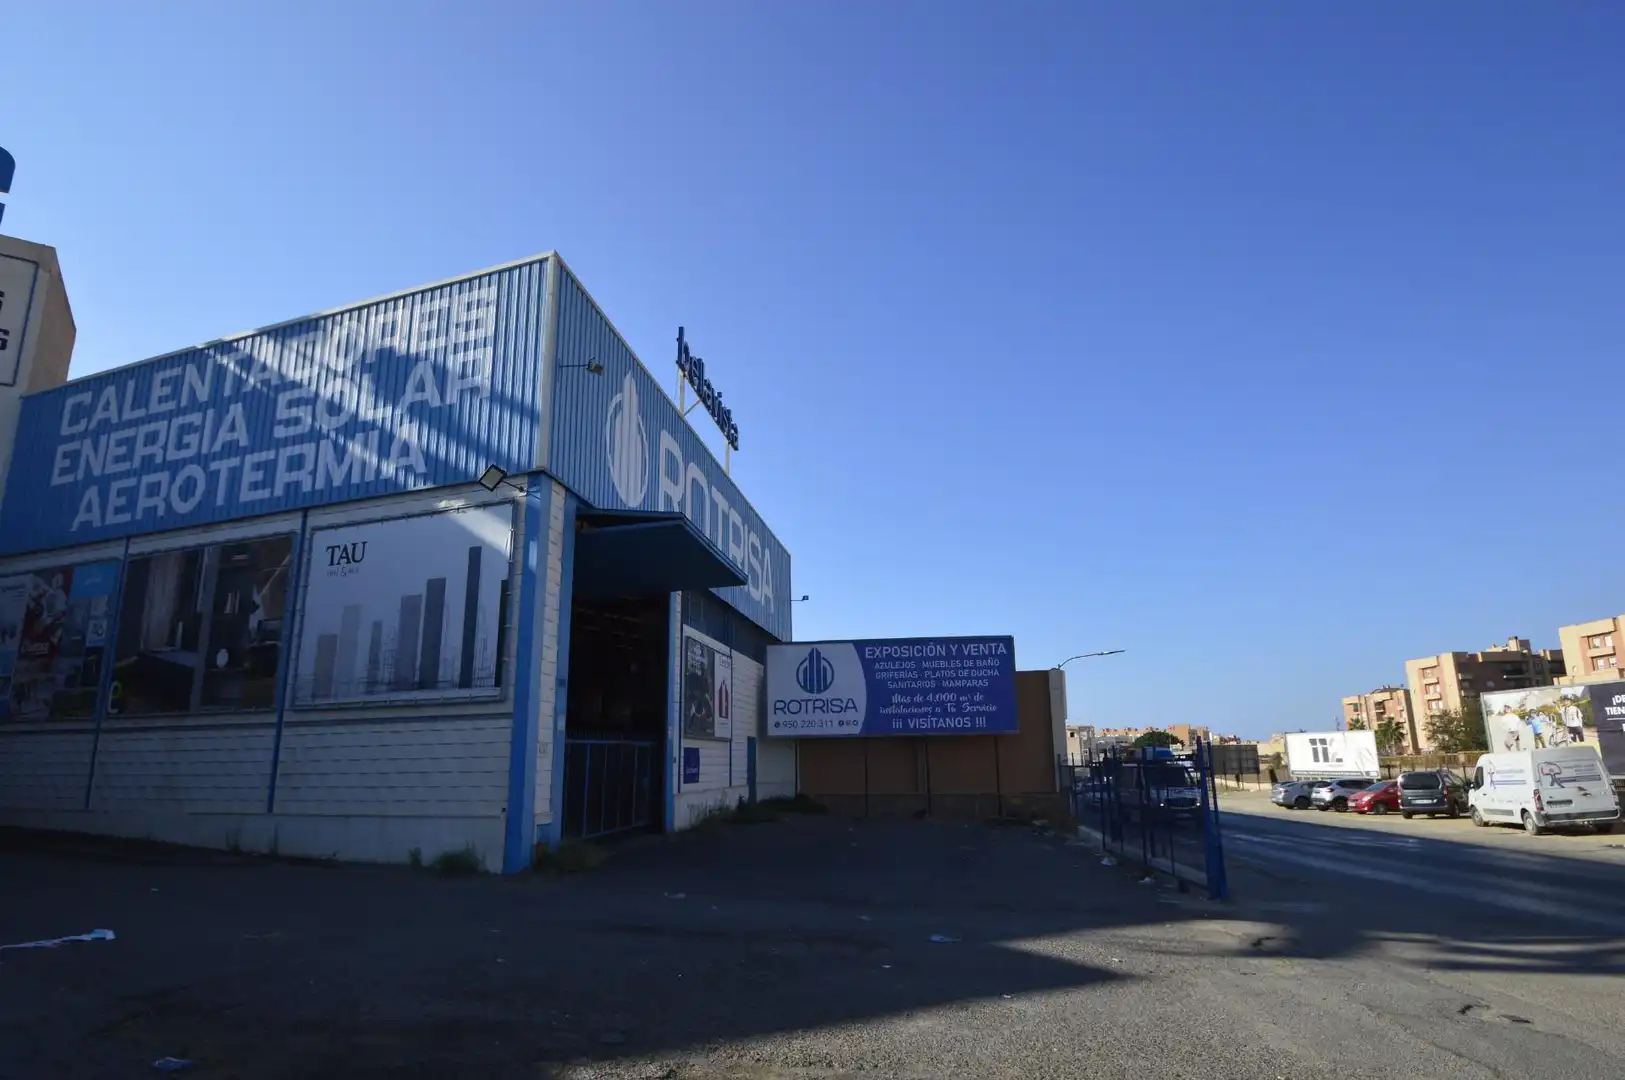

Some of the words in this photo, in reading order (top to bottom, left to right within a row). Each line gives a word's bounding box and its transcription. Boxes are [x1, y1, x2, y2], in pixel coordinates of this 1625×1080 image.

[51, 402, 249, 486] ENERGIA
[273, 346, 493, 438] SOLAR
[70, 422, 427, 532] AEROTERMIA
[658, 429, 774, 614] ROTRISA
[326, 541, 368, 566] TAU
[865, 642, 946, 658] EXPOSICIÓN
[950, 644, 958, 656] Y
[961, 643, 1007, 656] VENTA
[874, 661, 916, 669] AZULEJOS
[922, 659, 961, 668] MUEBLES
[963, 659, 974, 667] DE
[976, 657, 1000, 667] BAÑO
[924, 670, 956, 678] PLATOS
[958, 669, 969, 677] DE
[971, 668, 1000, 677] DUCHA
[887, 680, 936, 689] SANITARIOS
[942, 679, 989, 688] MAMPARAS
[914, 692, 924, 703] de
[773, 697, 858, 715] ROTRISA
[908, 716, 972, 729] VISÍTANOS
